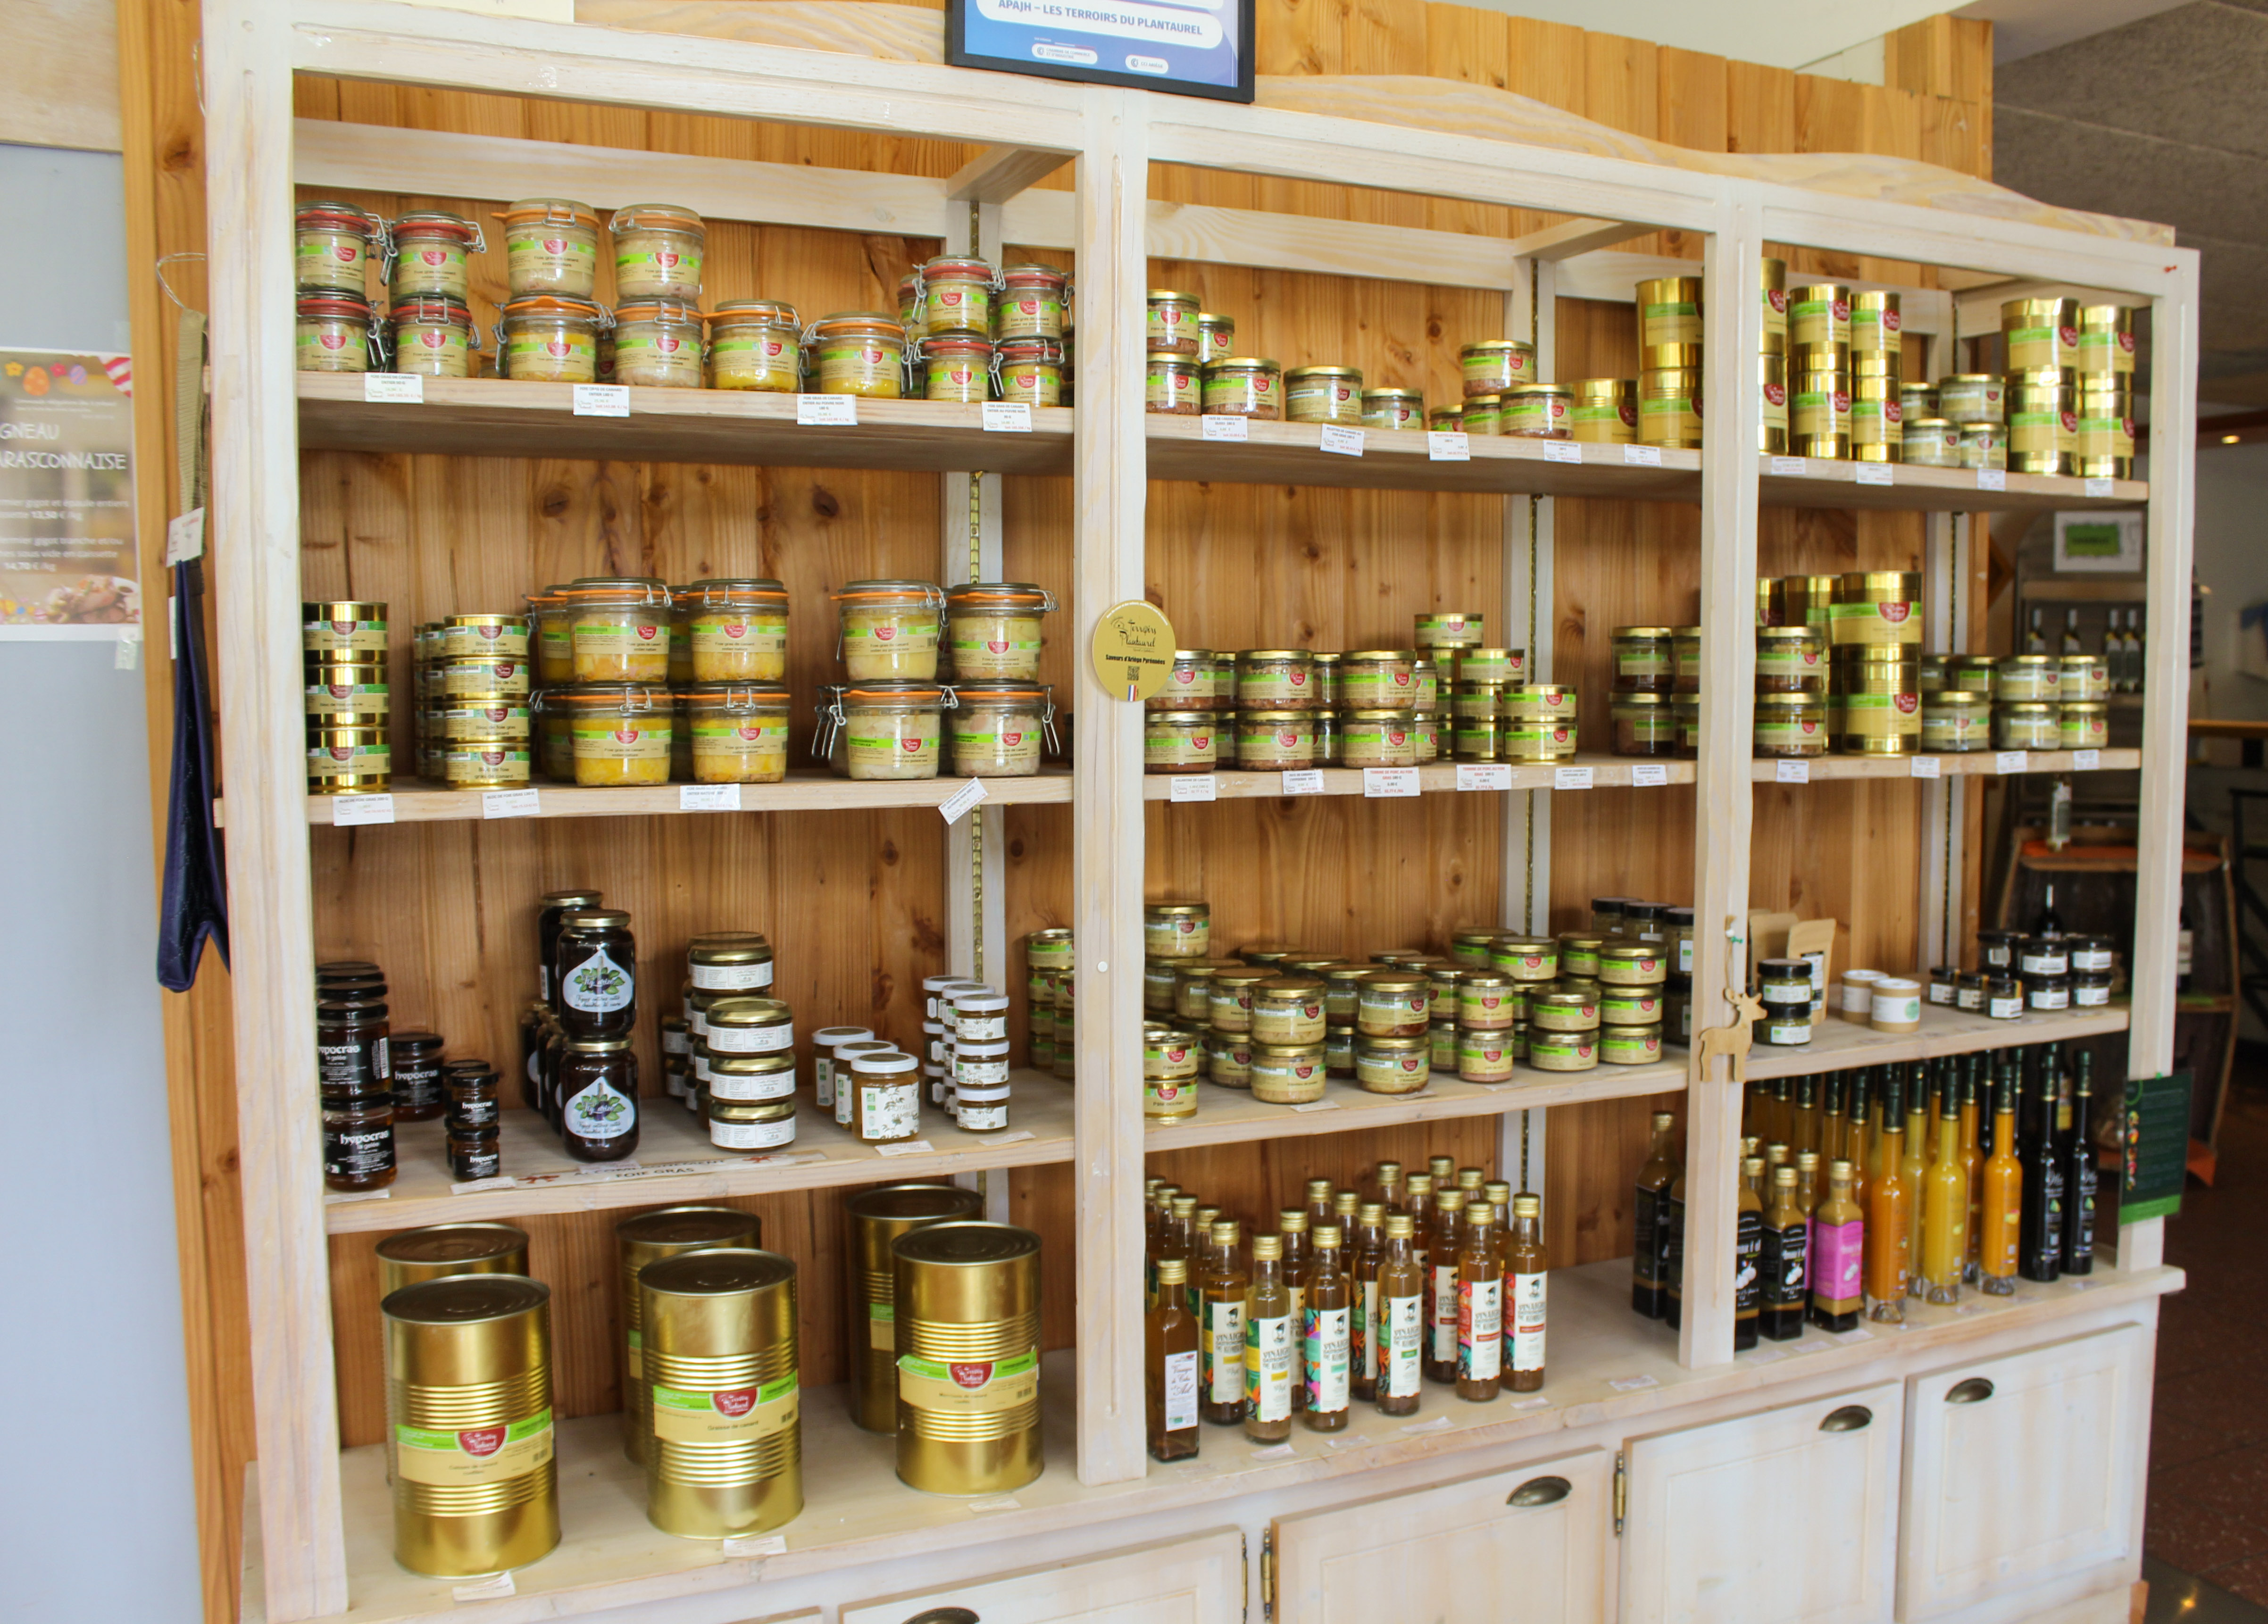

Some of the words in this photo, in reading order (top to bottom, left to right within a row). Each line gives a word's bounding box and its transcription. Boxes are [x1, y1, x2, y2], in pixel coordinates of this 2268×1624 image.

[999, 0, 1031, 12] APAJH
[1043, 4, 1062, 15] LES
[1065, 7, 1117, 23] TERROIRS
[1120, 15, 1134, 25] DU
[1137, 17, 1202, 35] PLANTAUREL
[317, 1044, 361, 1055] ypocras
[340, 1130, 389, 1145] hypocras
